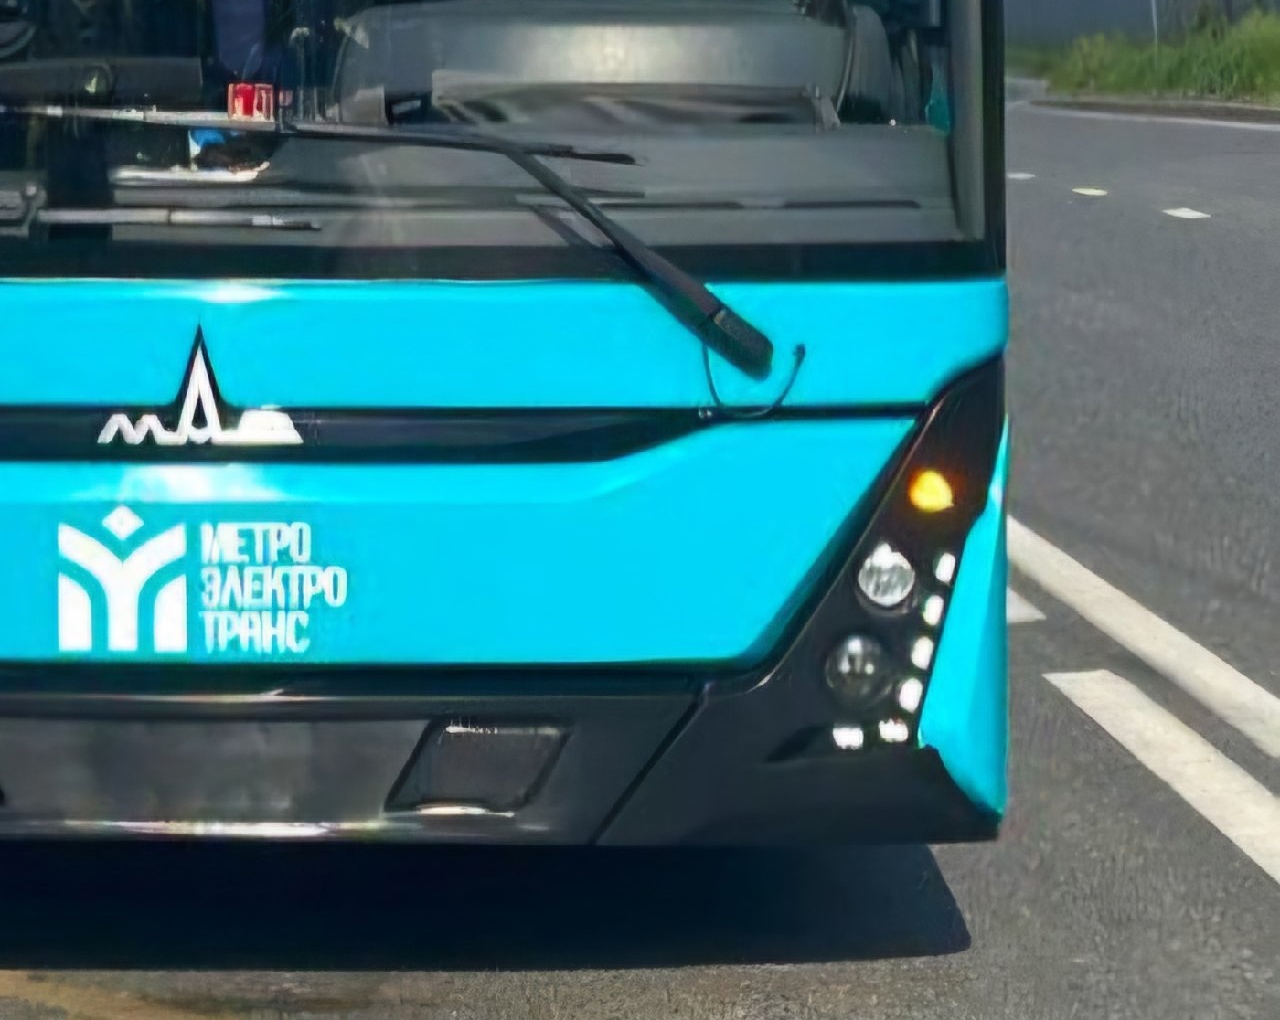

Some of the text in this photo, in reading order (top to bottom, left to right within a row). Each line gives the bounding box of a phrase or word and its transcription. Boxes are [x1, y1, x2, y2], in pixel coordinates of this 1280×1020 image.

[200, 521, 311, 564] МЕТРО
[200, 565, 348, 608] ЭЛЕКТРО
[200, 610, 311, 654] ТРАНС
